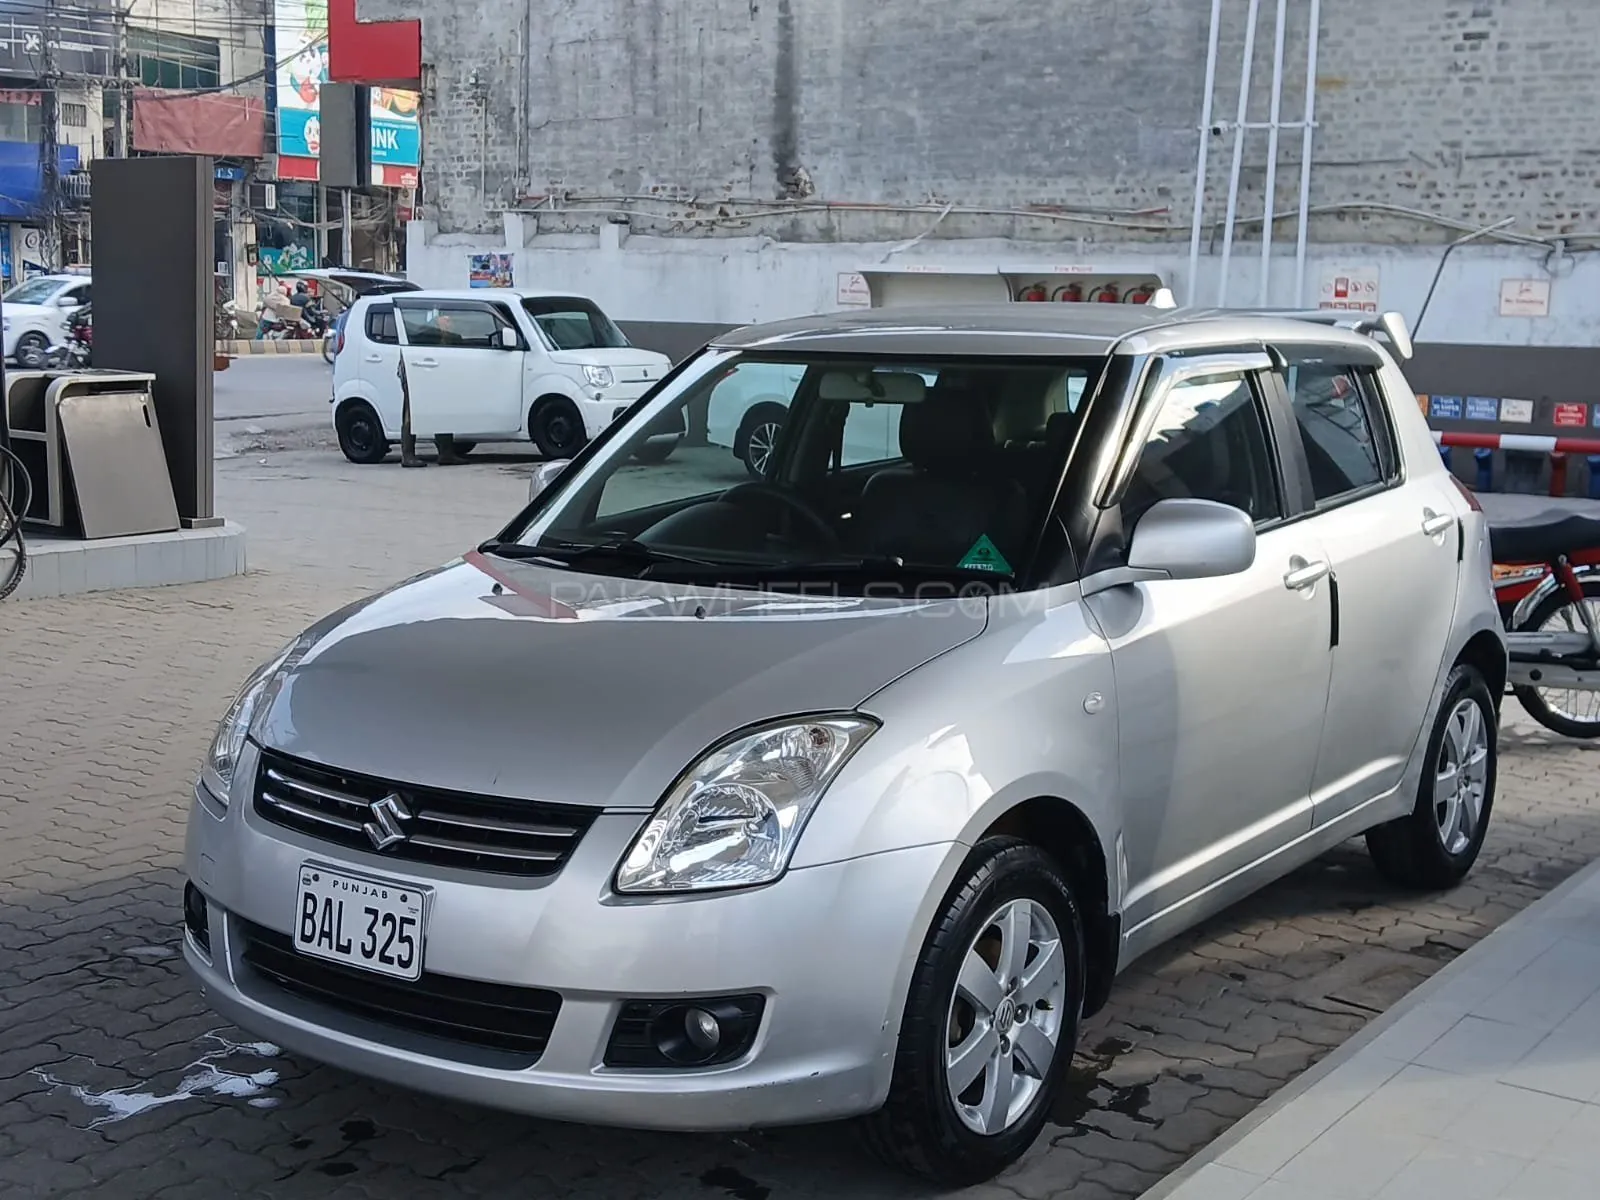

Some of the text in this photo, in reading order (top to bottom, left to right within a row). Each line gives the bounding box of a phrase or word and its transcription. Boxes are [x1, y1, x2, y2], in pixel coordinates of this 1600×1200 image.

[332, 880, 388, 899] PUNJAB
[300, 891, 417, 969] BAL 325
